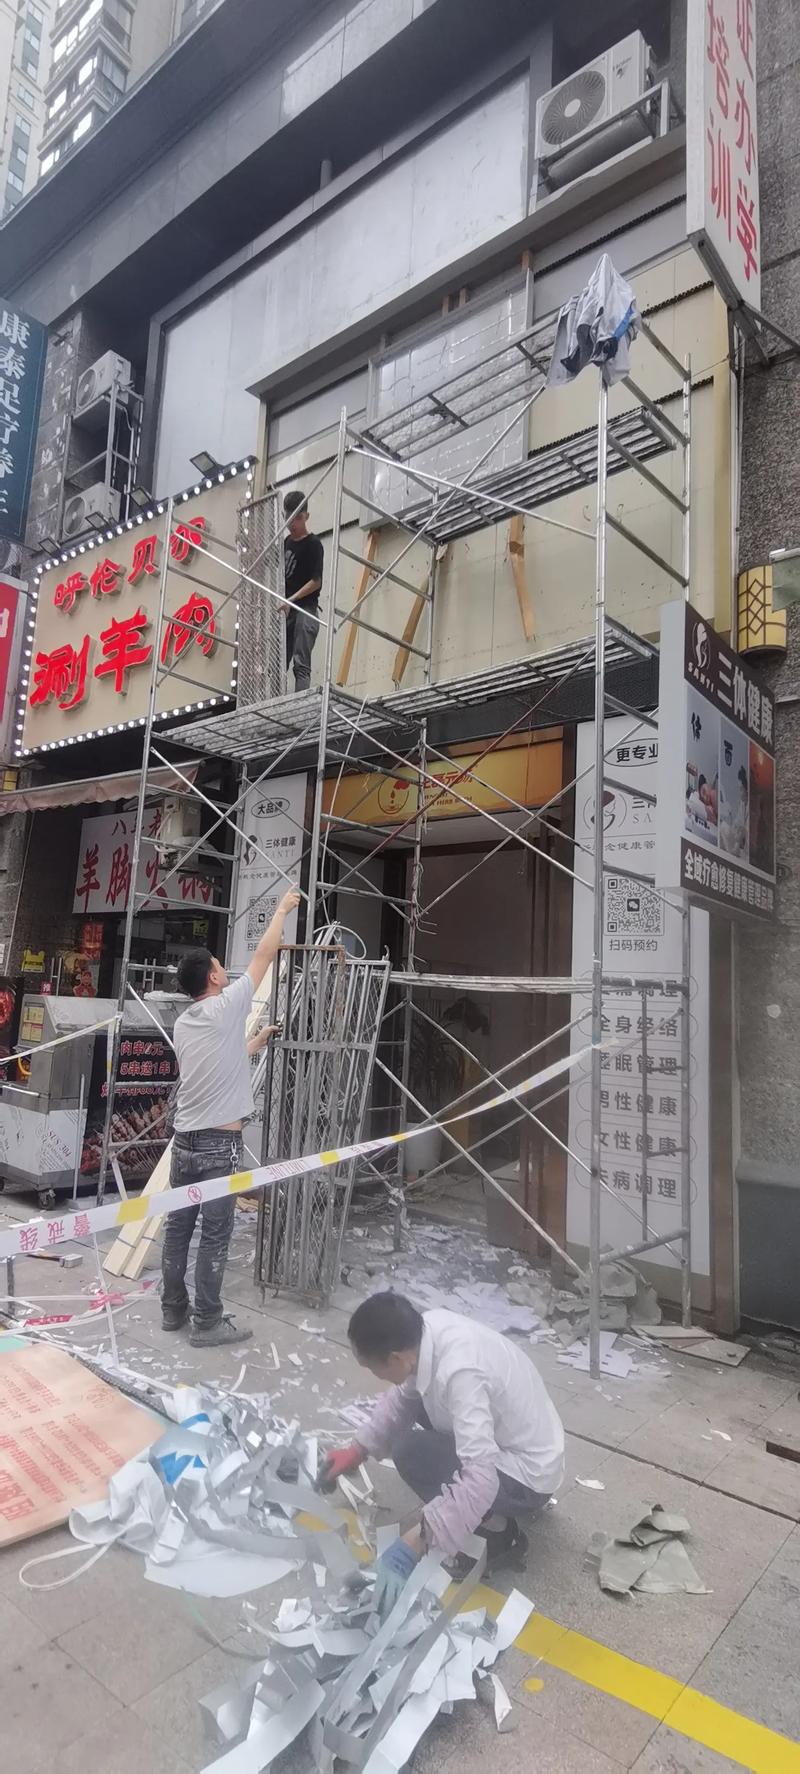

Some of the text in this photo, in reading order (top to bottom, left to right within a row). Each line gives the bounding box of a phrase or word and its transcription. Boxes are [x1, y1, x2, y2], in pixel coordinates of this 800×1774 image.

[54, 517, 206, 614] 呼伦贝尔
[29, 591, 216, 711] 涮羊肉
[717, 651, 774, 746] 三体健康
[265, 836, 296, 849] 三体健康
[609, 938, 658, 952] 扫码预约
[600, 1089, 678, 1116] 男性健康
[600, 1130, 678, 1157] 女性健康
[20, 1212, 92, 1251] 警戒线
